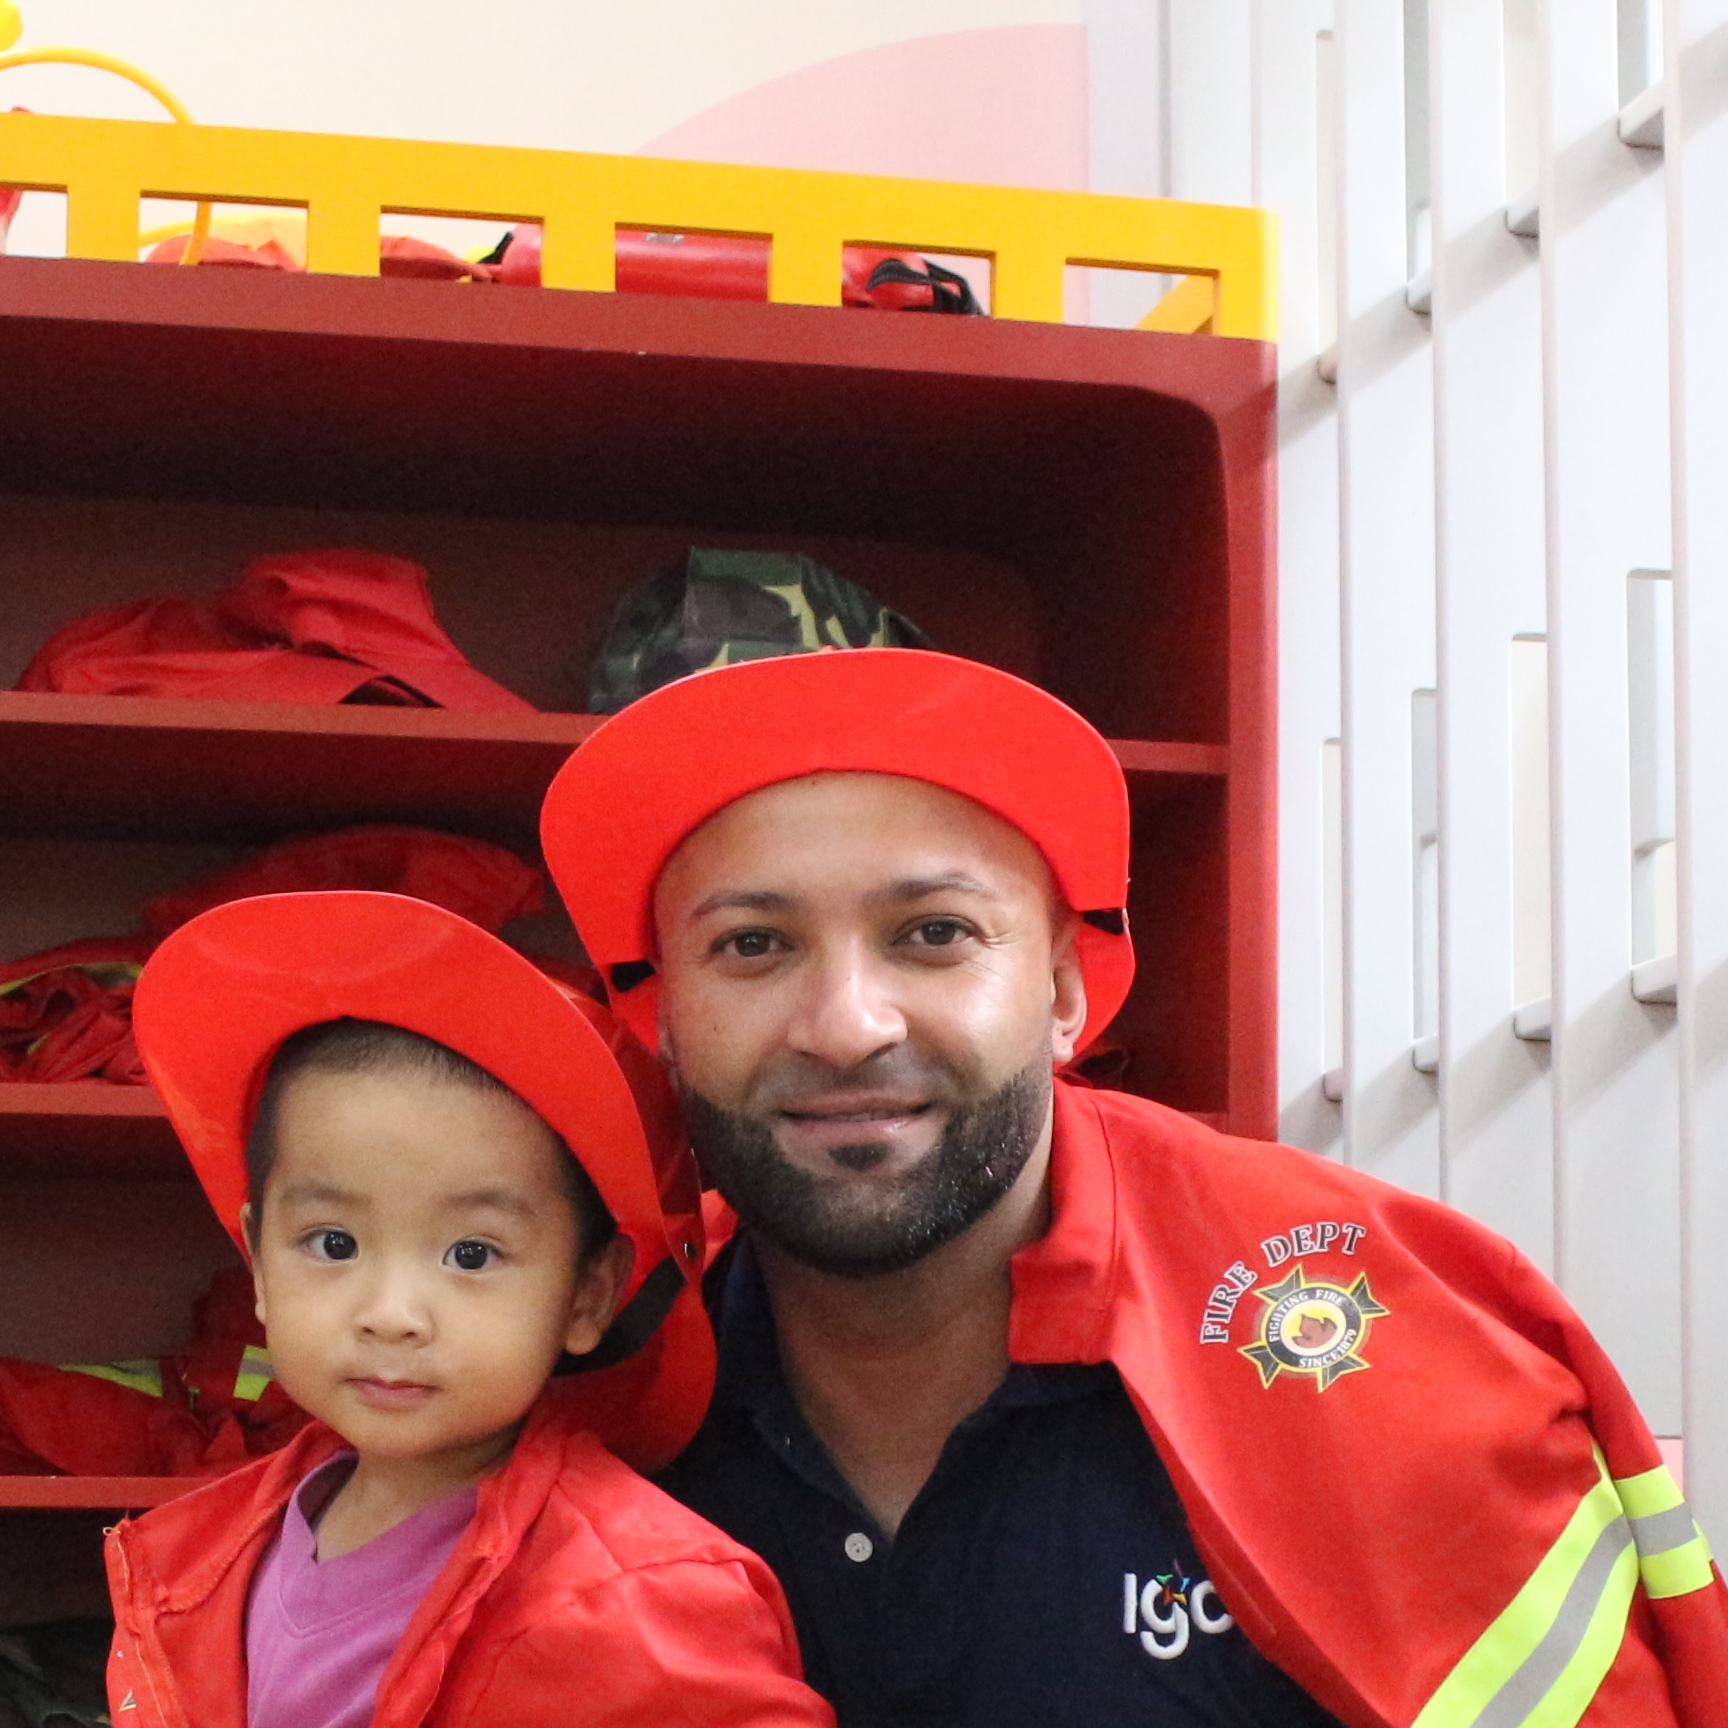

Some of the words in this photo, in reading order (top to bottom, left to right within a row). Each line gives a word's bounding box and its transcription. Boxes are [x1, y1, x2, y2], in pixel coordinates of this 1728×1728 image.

[1200, 1260, 1258, 1344] FIRE
[1260, 1222, 1366, 1267] DEPT
[1268, 1291, 1309, 1343] FIGHTING
[1315, 1289, 1346, 1307] FIRE
